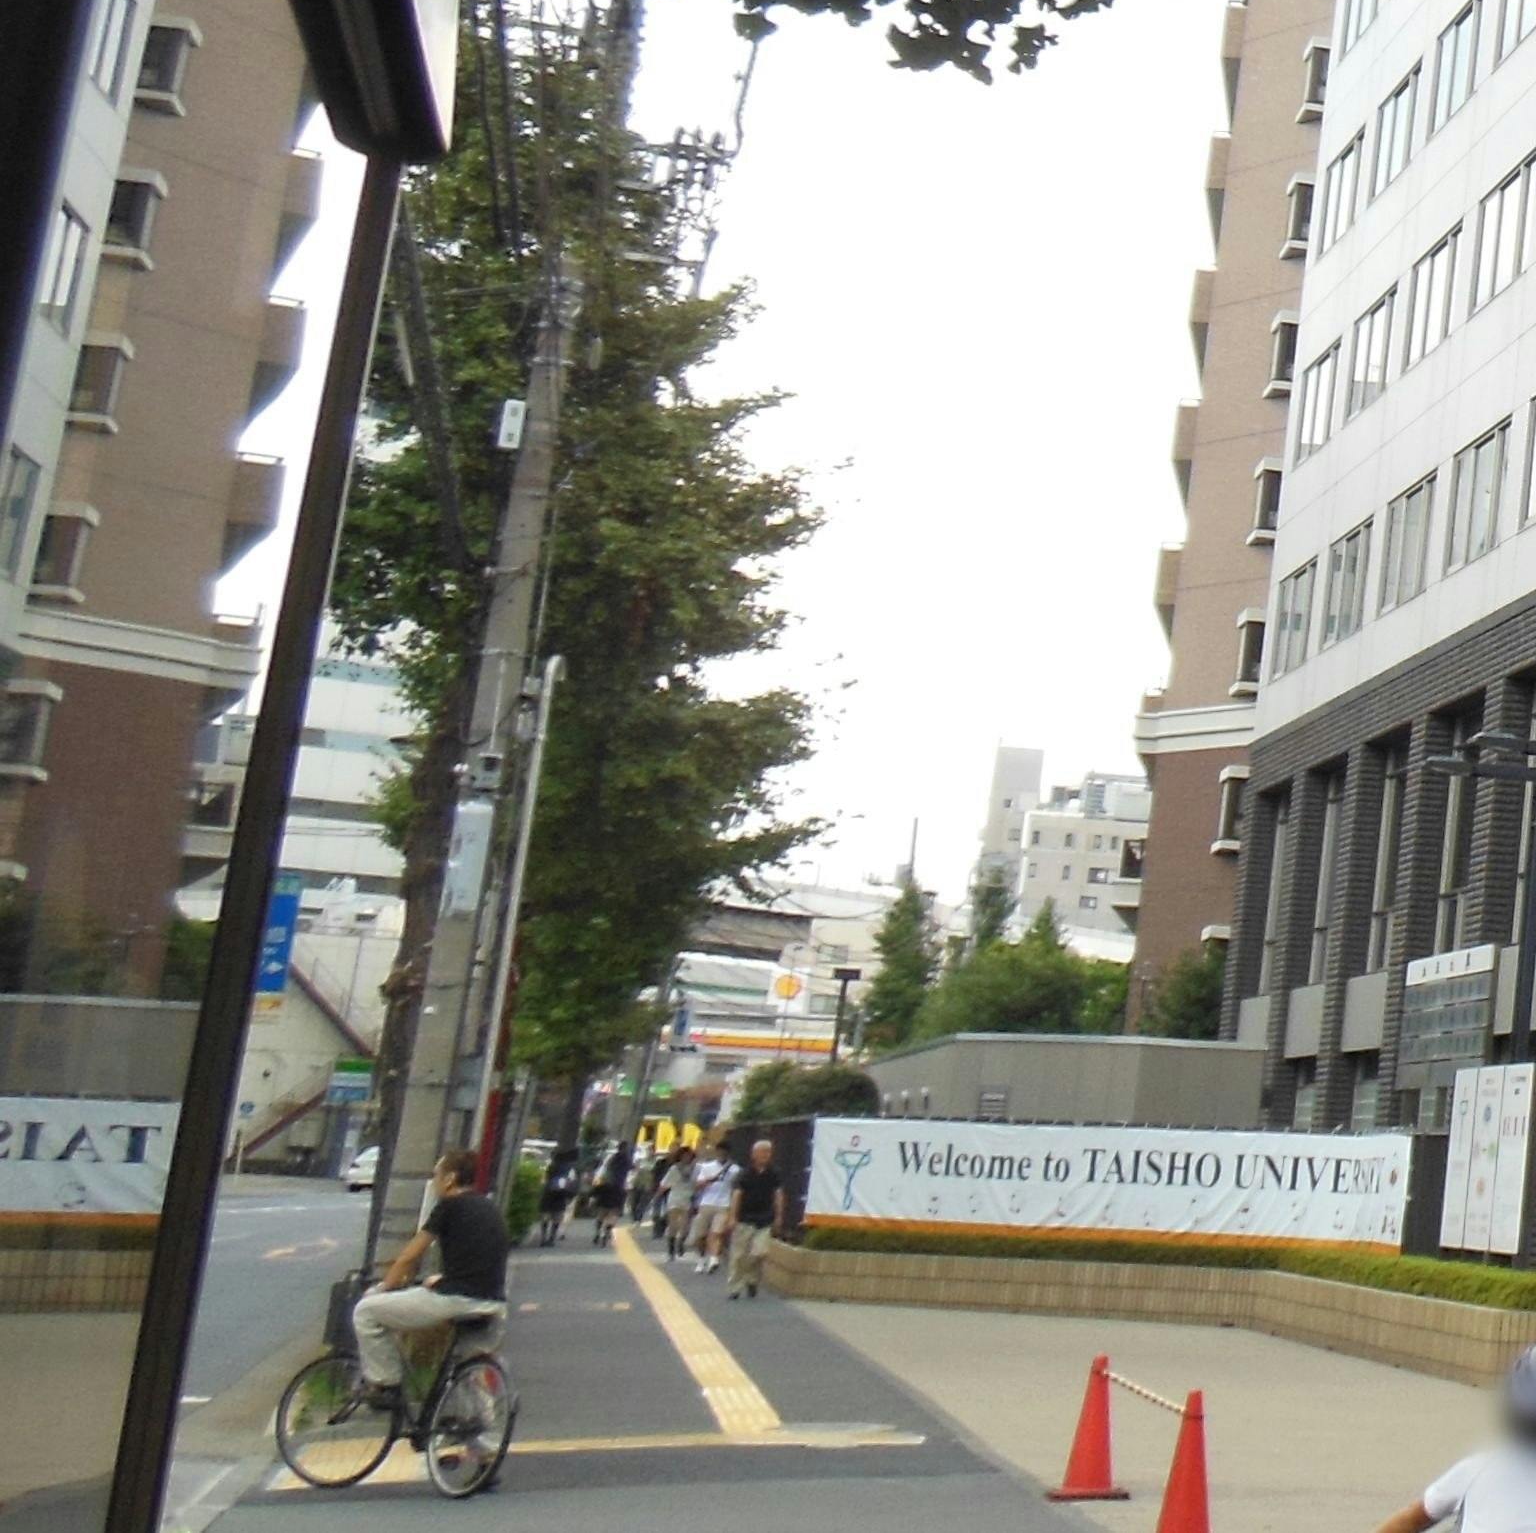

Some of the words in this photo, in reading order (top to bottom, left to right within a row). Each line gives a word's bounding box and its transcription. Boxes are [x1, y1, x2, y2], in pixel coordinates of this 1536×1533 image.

[898, 1140, 1031, 1181] Welcome
[1042, 1149, 1071, 1184] to
[1082, 1147, 1222, 1189] TAISHO
